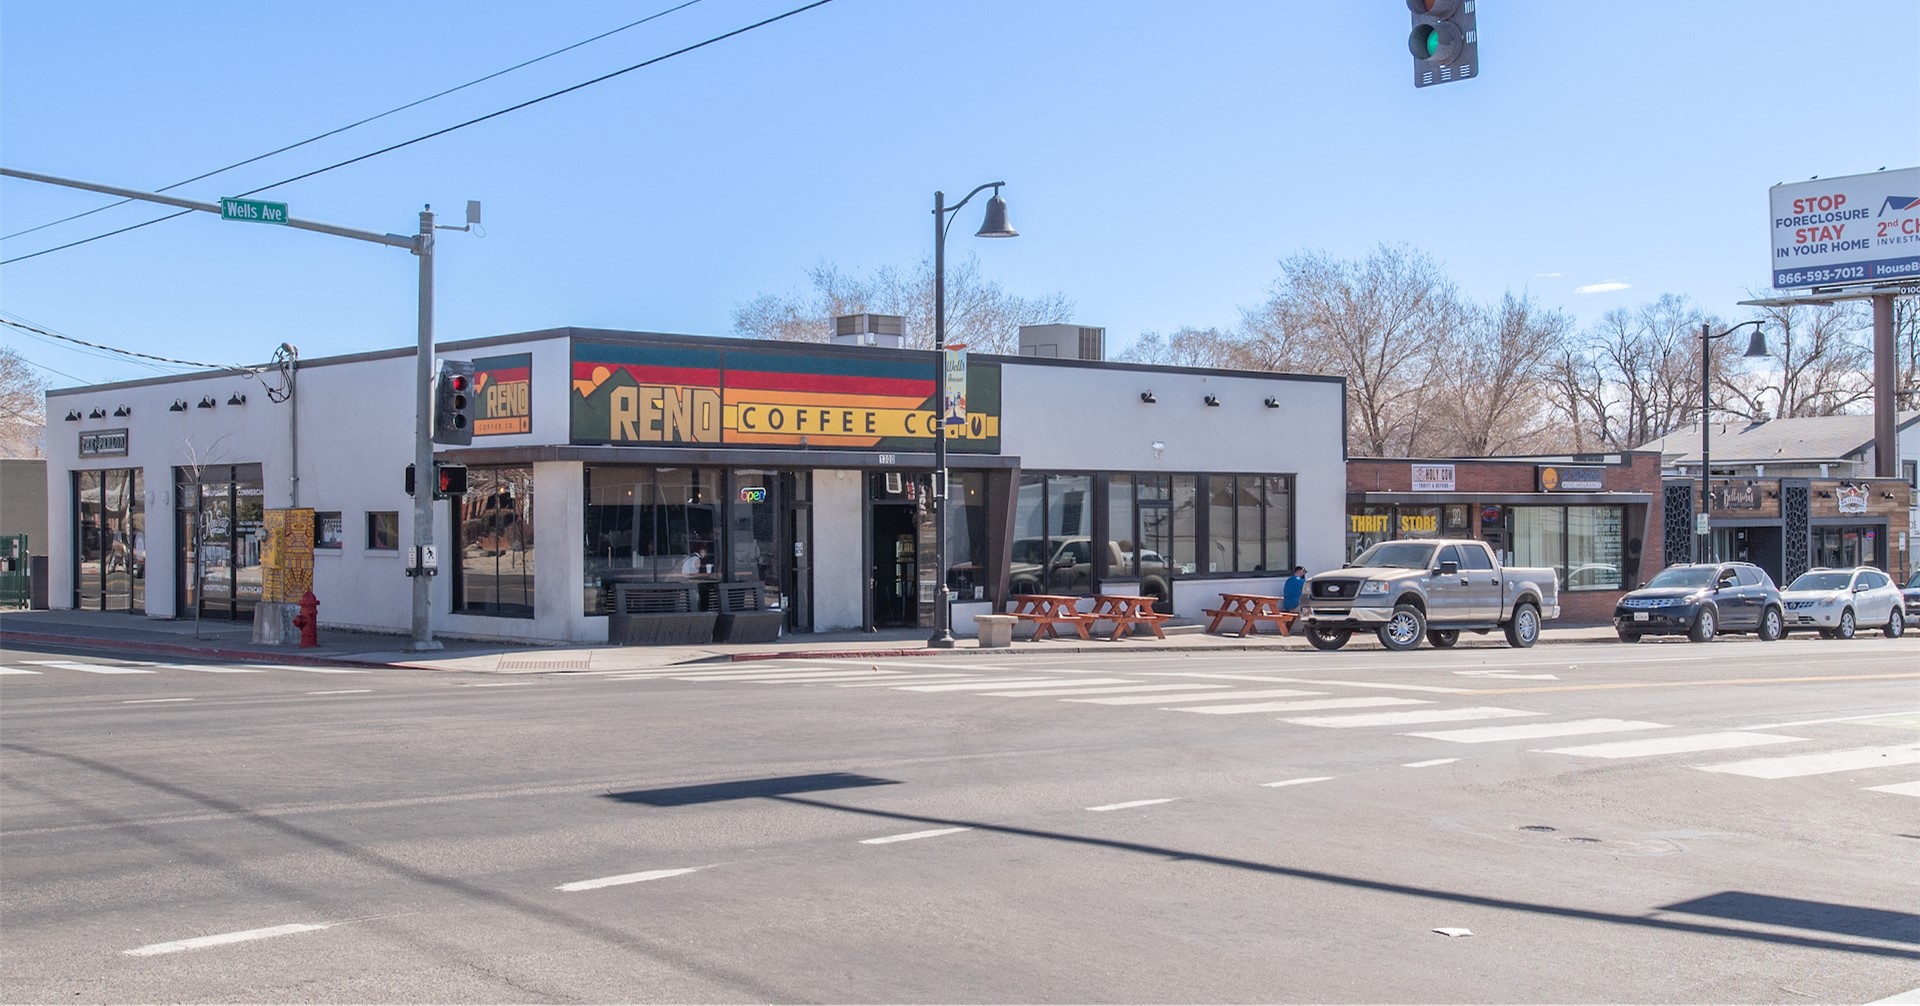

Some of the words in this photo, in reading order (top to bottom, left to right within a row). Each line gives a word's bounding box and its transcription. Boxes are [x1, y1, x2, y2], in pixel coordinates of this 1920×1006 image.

[227, 201, 258, 219] Wells
[262, 204, 282, 221] Ave
[1793, 194, 1847, 215] STOP
[1775, 208, 1870, 229] FORECLOSURE
[1877, 218, 1899, 238] 2nd
[1795, 223, 1846, 244] STAY
[1776, 247, 1790, 258] IN
[1793, 243, 1828, 256] YOUR
[1831, 238, 1870, 252] HOME
[1778, 266, 1865, 285] 866-593-7012
[1876, 261, 1920, 275] HouseB
[946, 359, 965, 372] Wells
[487, 382, 529, 418] RENO
[610, 385, 721, 443] RENO
[742, 407, 876, 434] COFFEE
[98, 435, 125, 450] PARLOR
[1425, 468, 1439, 481] HOLY
[1441, 468, 1453, 481] COW
[741, 490, 766, 503] open
[323, 519, 342, 533] COFFEE
[1351, 515, 1389, 533] THRIFT
[1401, 515, 1437, 532] STORE
